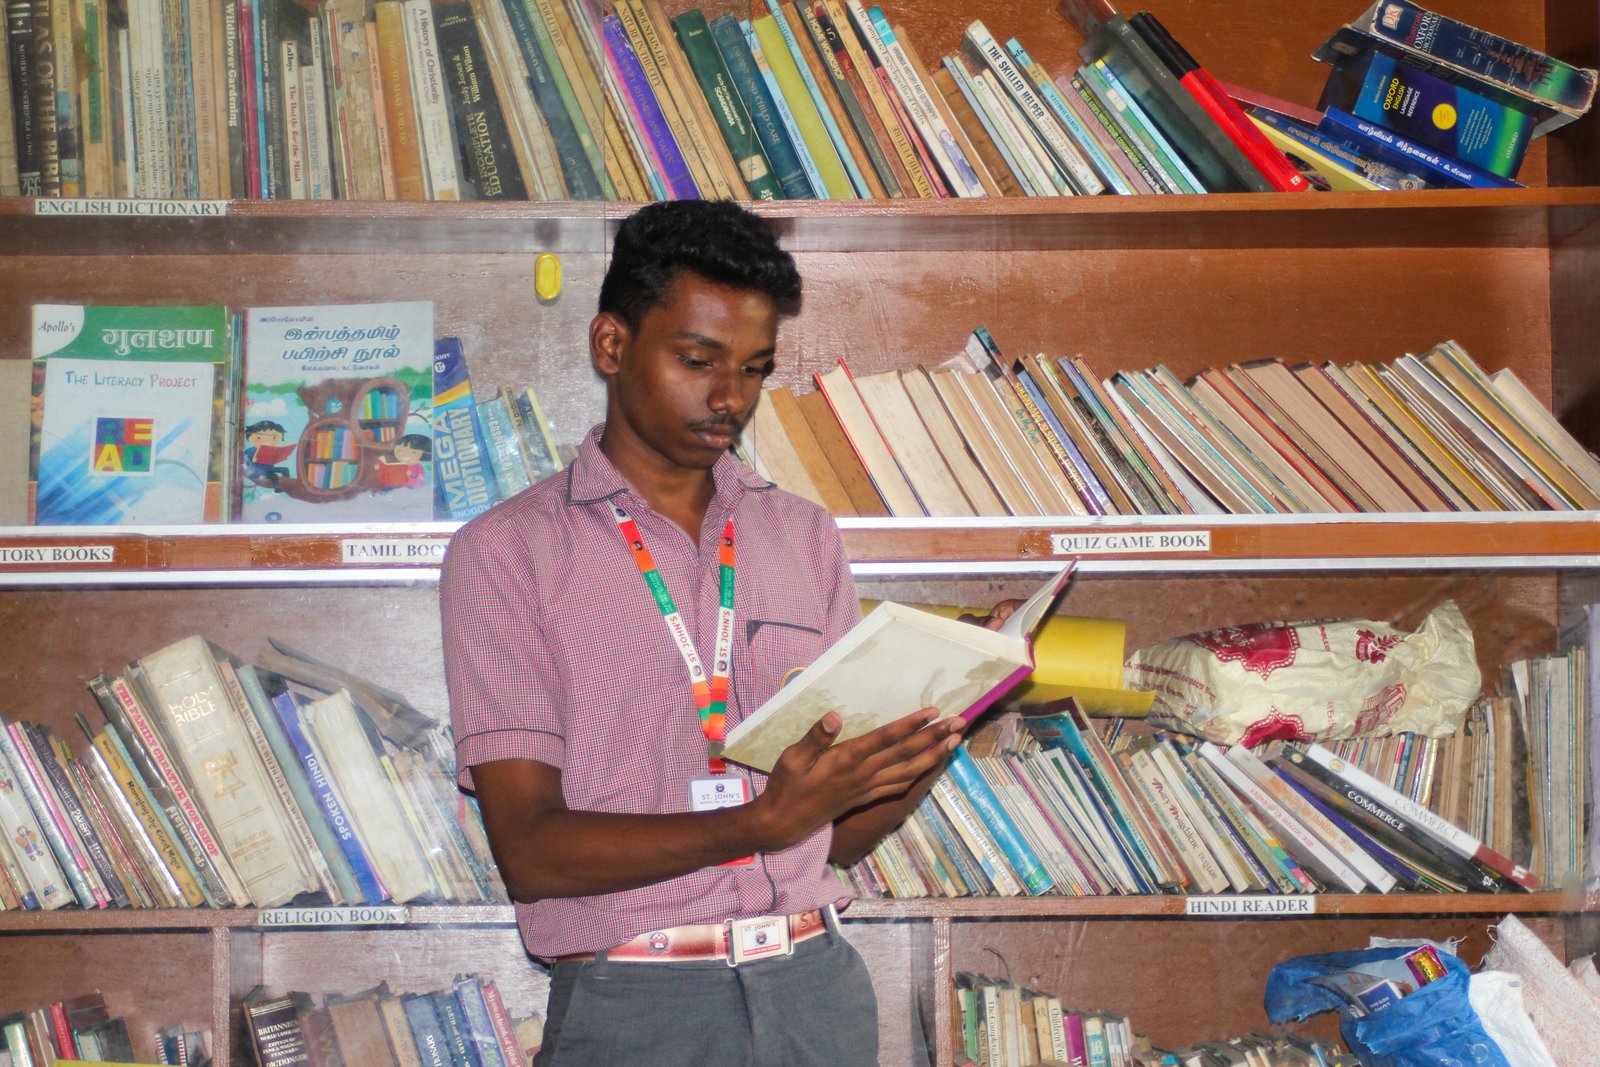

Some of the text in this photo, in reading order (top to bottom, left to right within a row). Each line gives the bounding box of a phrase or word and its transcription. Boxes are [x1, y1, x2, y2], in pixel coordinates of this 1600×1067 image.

[418, 7, 427, 16] A
[537, 0, 566, 48] POLLUTION
[770, 6, 795, 48] Christians
[1380, 5, 1402, 29] DK
[1403, 9, 1427, 46] Illustrate
[1411, 10, 1435, 50] OXFORD
[418, 16, 432, 47] History
[618, 6, 663, 88] NATURE IN THE CITY
[633, 6, 670, 71] MOUNTAIN LIFE
[801, 5, 846, 82] THE HOME WORKSHOP
[224, 2, 238, 127] Wildflower Gardening
[424, 47, 434, 57] of
[855, 5, 927, 126] The Complete Encyclopedia of Crafts
[424, 57, 441, 105] Christianity
[451, 53, 472, 106] Judy Jones &
[461, 44, 481, 102] William Wilson
[890, 45, 939, 121] VIRGINIA HISTORY AND GEOGRAPHY
[986, 44, 1003, 63] THE
[997, 58, 1025, 93] SKILLED
[1019, 89, 1045, 120] HELPER
[1372, 74, 1388, 104] Indian Edition
[713, 85, 735, 126] SCANDINAVIA
[715, 72, 746, 136] Facts On File National Profiles
[746, 76, 781, 145] AND CHILD CARE
[1048, 92, 1080, 133] NORTH DAKOTA
[1381, 76, 1400, 112] OXFORD
[1391, 84, 1406, 110] ENGLISH
[1398, 85, 1414, 115] LANGUAGE
[1406, 89, 1421, 118] REFERENCE
[465, 112, 492, 197] AN INCOMPLETE
[473, 110, 503, 195] EDUCATION
[890, 124, 927, 186] IN THE FUTURE
[1504, 129, 1520, 159] OXFORD
[38, 201, 223, 214] ENGLISH DICTIONARY
[38, 320, 76, 333] Apollo's
[352, 344, 401, 363] நூல்
[1013, 379, 1044, 423] Mysteries
[1014, 406, 1042, 445] On My Own
[1038, 420, 1049, 432] &
[1043, 429, 1067, 459] Myths
[434, 408, 467, 511] MEGA
[450, 407, 492, 505] DICTIONARY
[52, 548, 111, 561] BOOKS
[347, 545, 402, 556] TAMIL
[1060, 534, 1207, 552] QUIZ GAME BOOK
[669, 615, 690, 649] JOHN'S
[721, 610, 731, 643] JOHN'S
[719, 643, 728, 659] ST.
[168, 686, 214, 712] HOLY
[174, 702, 217, 727] BIBLE
[113, 682, 134, 708] THE
[127, 706, 157, 749] FAMILY
[150, 746, 187, 800] CREATIVE
[180, 799, 220, 858] WORKSHOP
[302, 752, 354, 841] SPOKEN HINDI
[715, 792, 741, 801] JOHN'S
[1149, 775, 1202, 852] Mary Magdalene
[1347, 790, 1405, 833] COMMERCE
[69, 807, 94, 839] PARENT
[948, 792, 968, 815] Than
[983, 845, 998, 860] All
[1395, 797, 1462, 842] COMMERCE
[87, 841, 116, 881] HASTINGS
[1196, 850, 1219, 881] TRAYLOR
[262, 909, 398, 925] RELIGION BOOK
[1190, 897, 1310, 913] HINDI READER
[755, 923, 777, 932] JOHN'S
[486, 990, 496, 1002] My
[490, 1000, 502, 1019] own
[444, 1004, 467, 1055] EARTH STARS
[495, 1017, 509, 1037] book
[502, 1035, 512, 1044] of
[987, 1000, 999, 1051] The Complete
[1049, 1006, 1065, 1048] Children's
